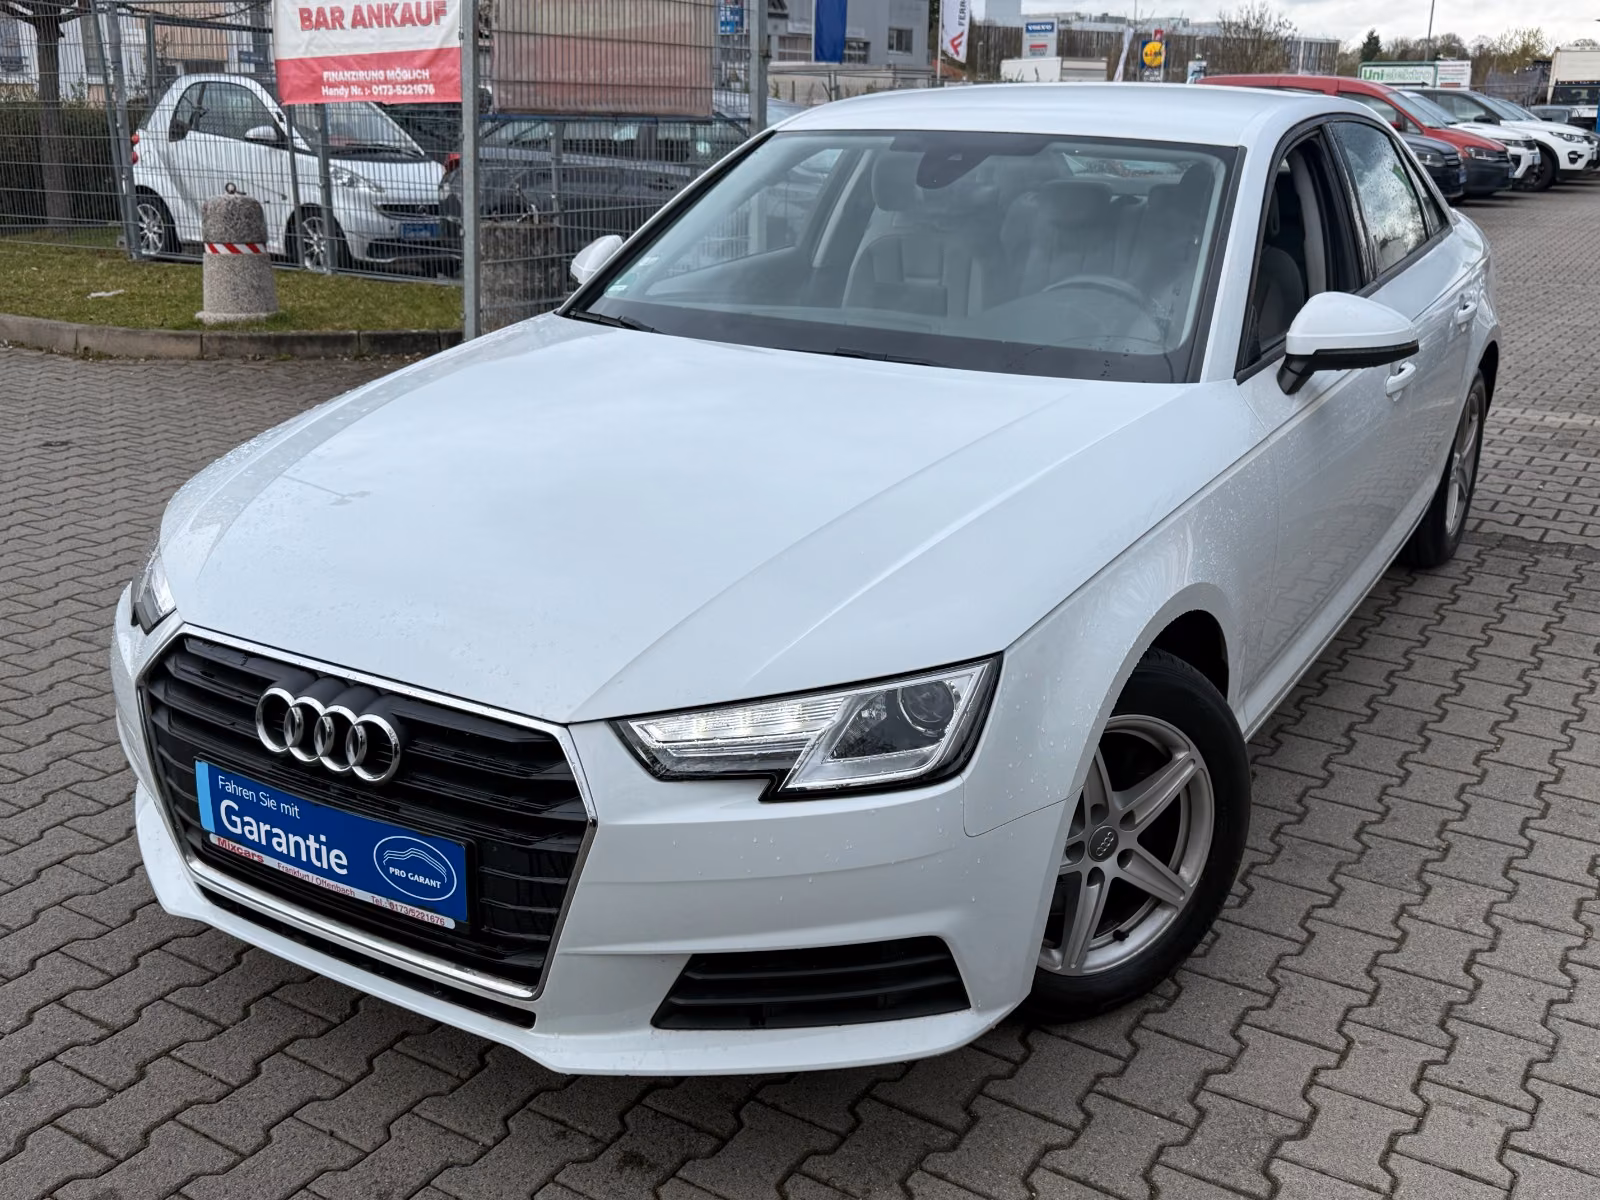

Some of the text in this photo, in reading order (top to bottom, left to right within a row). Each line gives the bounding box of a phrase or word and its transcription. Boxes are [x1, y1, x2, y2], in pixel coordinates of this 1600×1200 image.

[298, 0, 447, 31] BAR ANKAUF
[322, 67, 430, 82] FINANZIRUNG MÖGLICH
[321, 85, 349, 98] Handy
[218, 775, 300, 819] Fahren Sie mit
[220, 799, 348, 875] Garantie
[216, 837, 265, 864] Mixcars
[277, 861, 310, 880] Frankfurt
[315, 877, 356, 897] Offenbach
[389, 866, 441, 889] PRO GARANT
